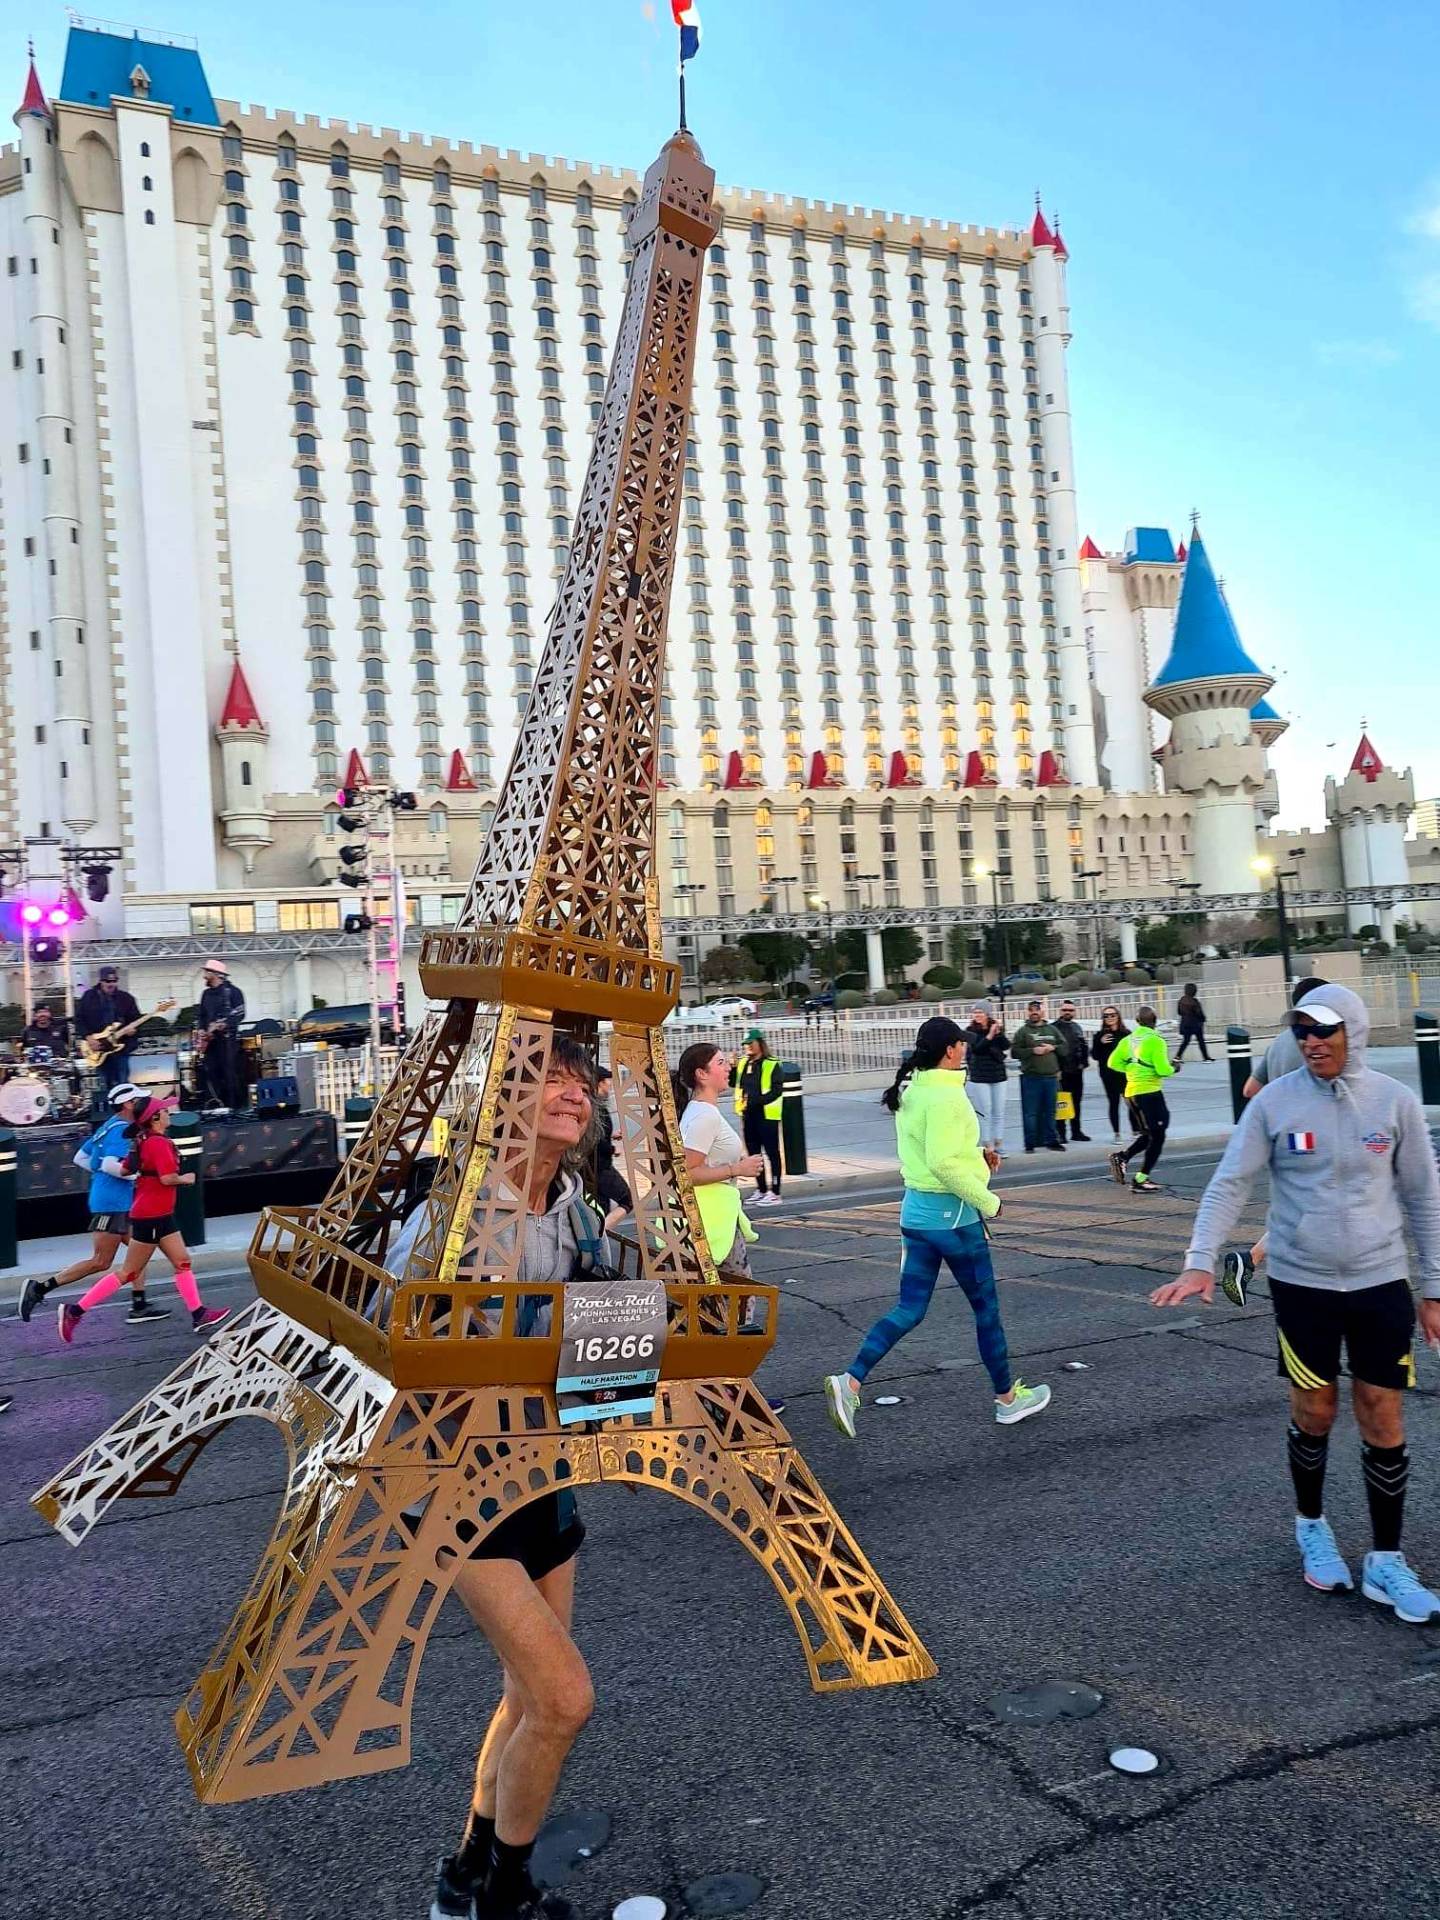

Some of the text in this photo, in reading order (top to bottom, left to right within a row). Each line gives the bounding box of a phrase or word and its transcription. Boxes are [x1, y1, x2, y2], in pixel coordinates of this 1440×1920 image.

[612, 1315, 641, 1323] VEGAS
[575, 1334, 655, 1362] 16266
[580, 1377, 600, 1385] HALF
[600, 1374, 638, 1383] MARATHON
